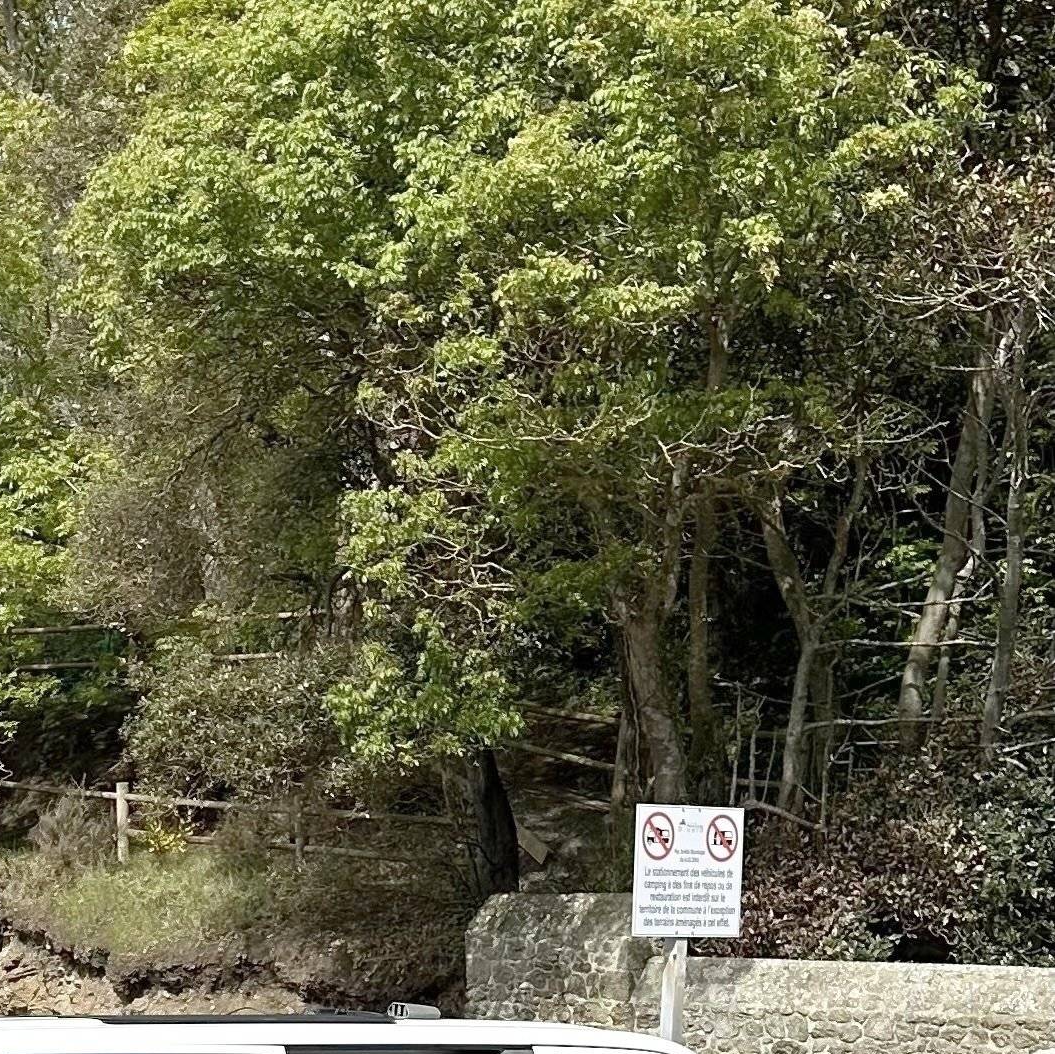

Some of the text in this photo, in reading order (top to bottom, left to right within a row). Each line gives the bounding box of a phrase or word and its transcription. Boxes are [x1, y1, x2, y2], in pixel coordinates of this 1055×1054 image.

[690, 867, 699, 877] des
[644, 881, 666, 891] camping
[672, 880, 682, 889] des
[694, 881, 701, 889] de
[702, 882, 716, 891] repos
[726, 881, 732, 889] de
[650, 893, 725, 902] restauration est interdit sur le
[639, 905, 661, 914] territoire
[663, 905, 670, 914] de
[677, 906, 702, 914] commune
[643, 917, 653, 926] des
[654, 918, 674, 926] terrains
